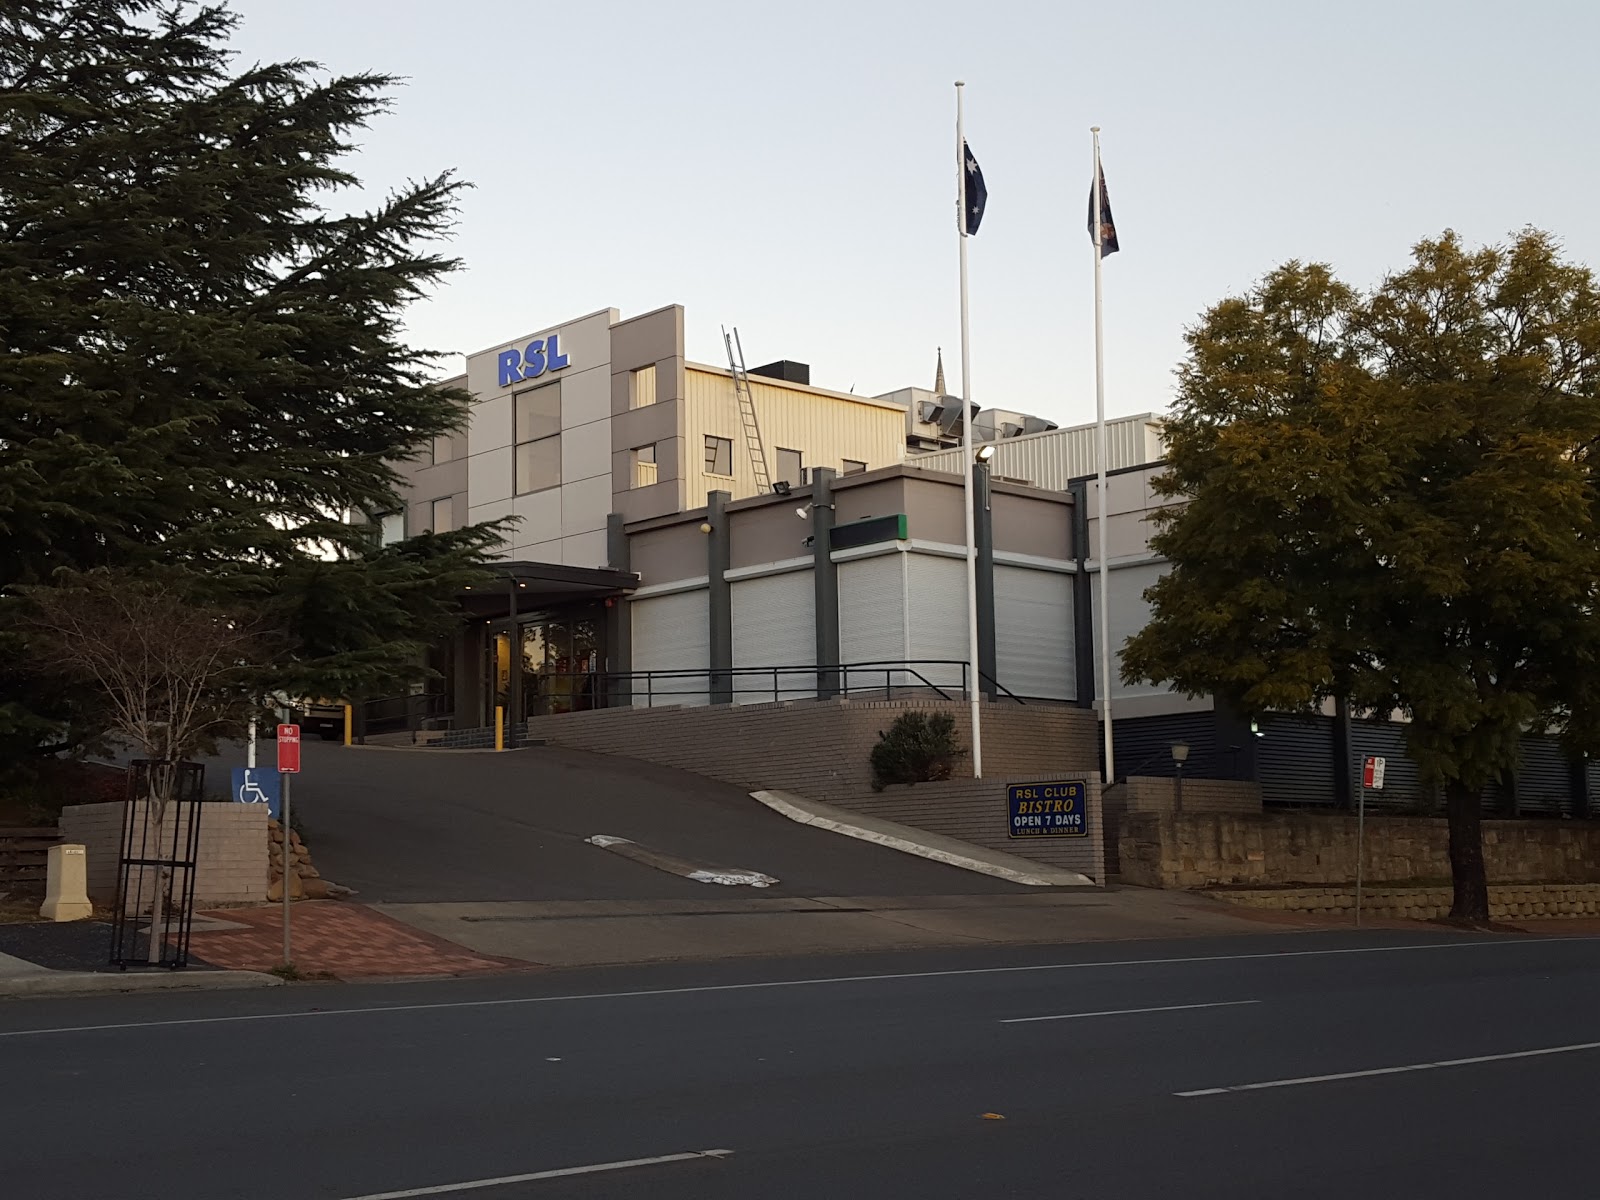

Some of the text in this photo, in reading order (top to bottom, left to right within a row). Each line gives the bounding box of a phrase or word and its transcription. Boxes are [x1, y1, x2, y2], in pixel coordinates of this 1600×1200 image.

[498, 334, 570, 388] RSL
[283, 727, 293, 735] NO
[1016, 786, 1077, 799] RSL CLUB
[1018, 799, 1074, 814] BISTRO
[1013, 814, 1081, 827] OPEN 7 DAYS
[1016, 827, 1040, 835] LUNCH
[1050, 826, 1079, 834] DINNER
